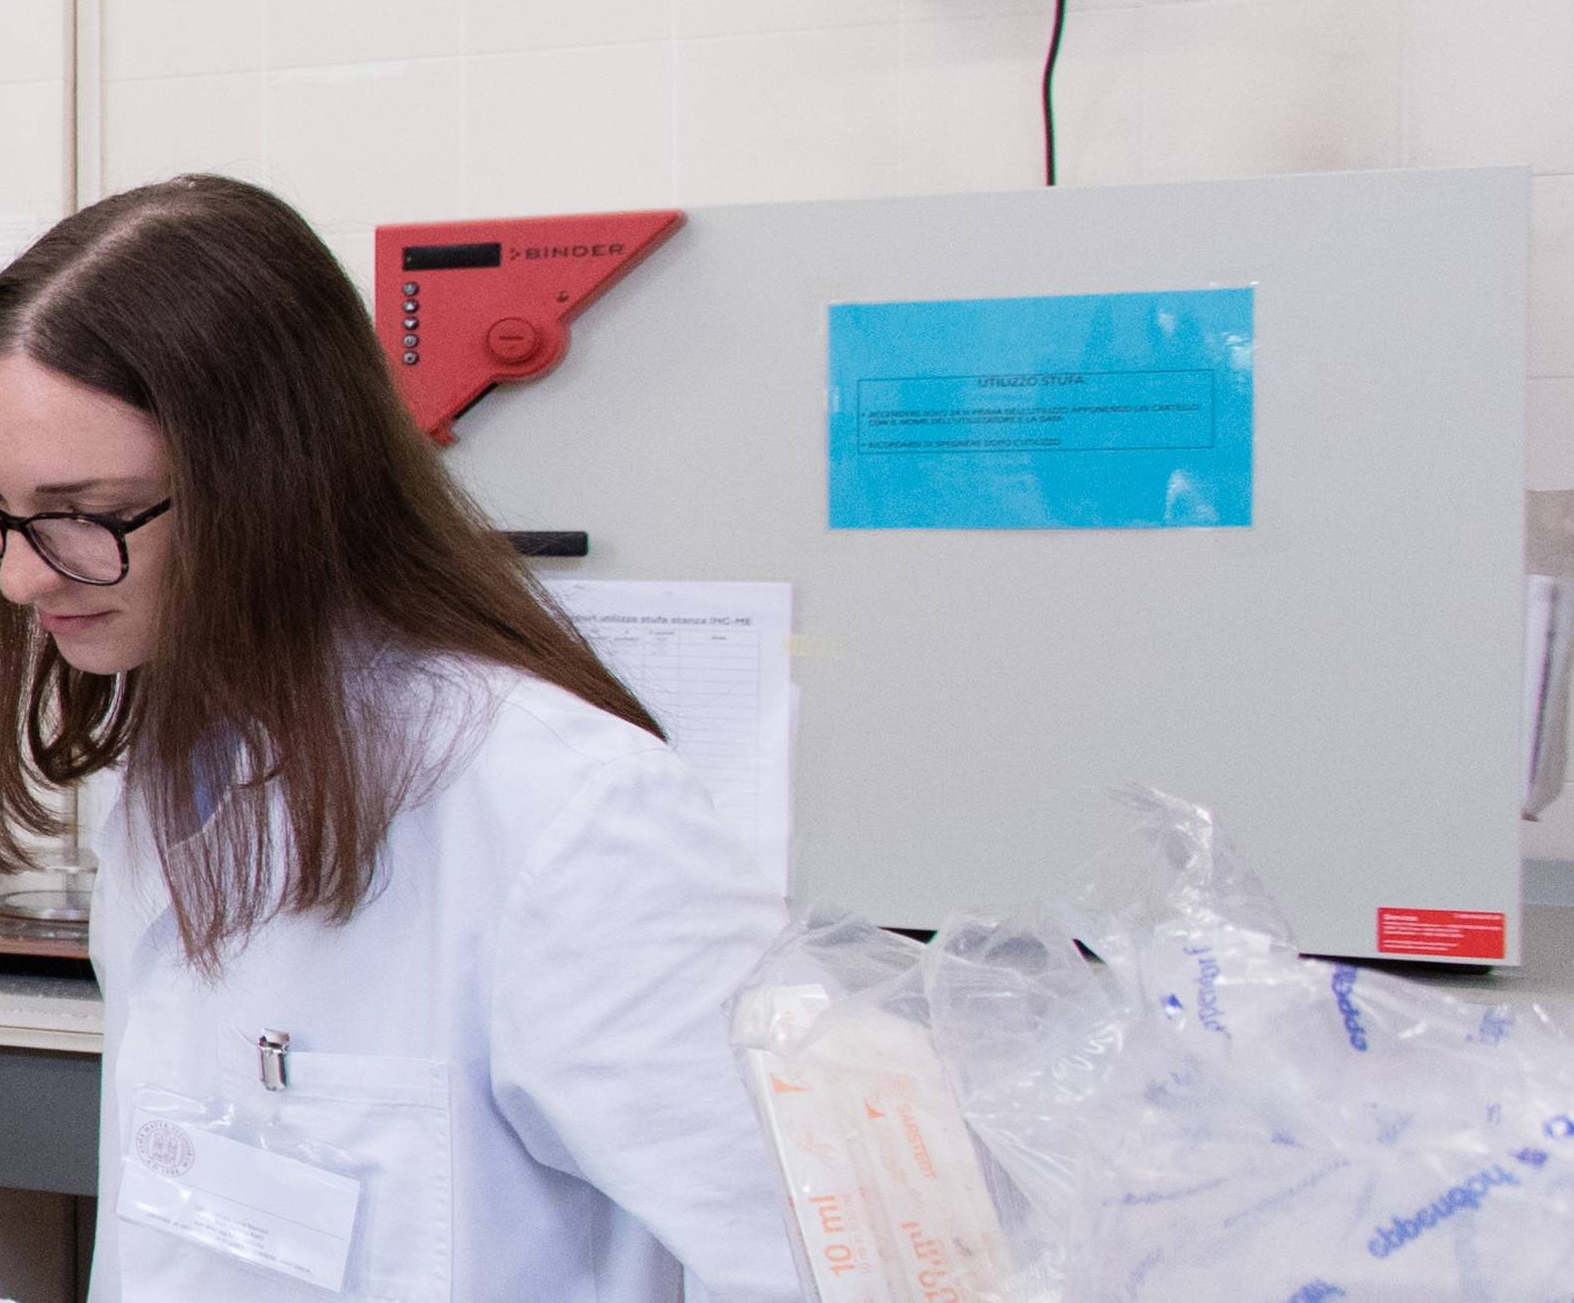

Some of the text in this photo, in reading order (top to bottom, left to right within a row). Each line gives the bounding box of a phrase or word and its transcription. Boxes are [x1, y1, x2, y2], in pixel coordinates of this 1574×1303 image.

[524, 242, 626, 260] BINDER
[976, 374, 1085, 388] UTILIZZO STUFA
[808, 1194, 856, 1277] 10 ml
